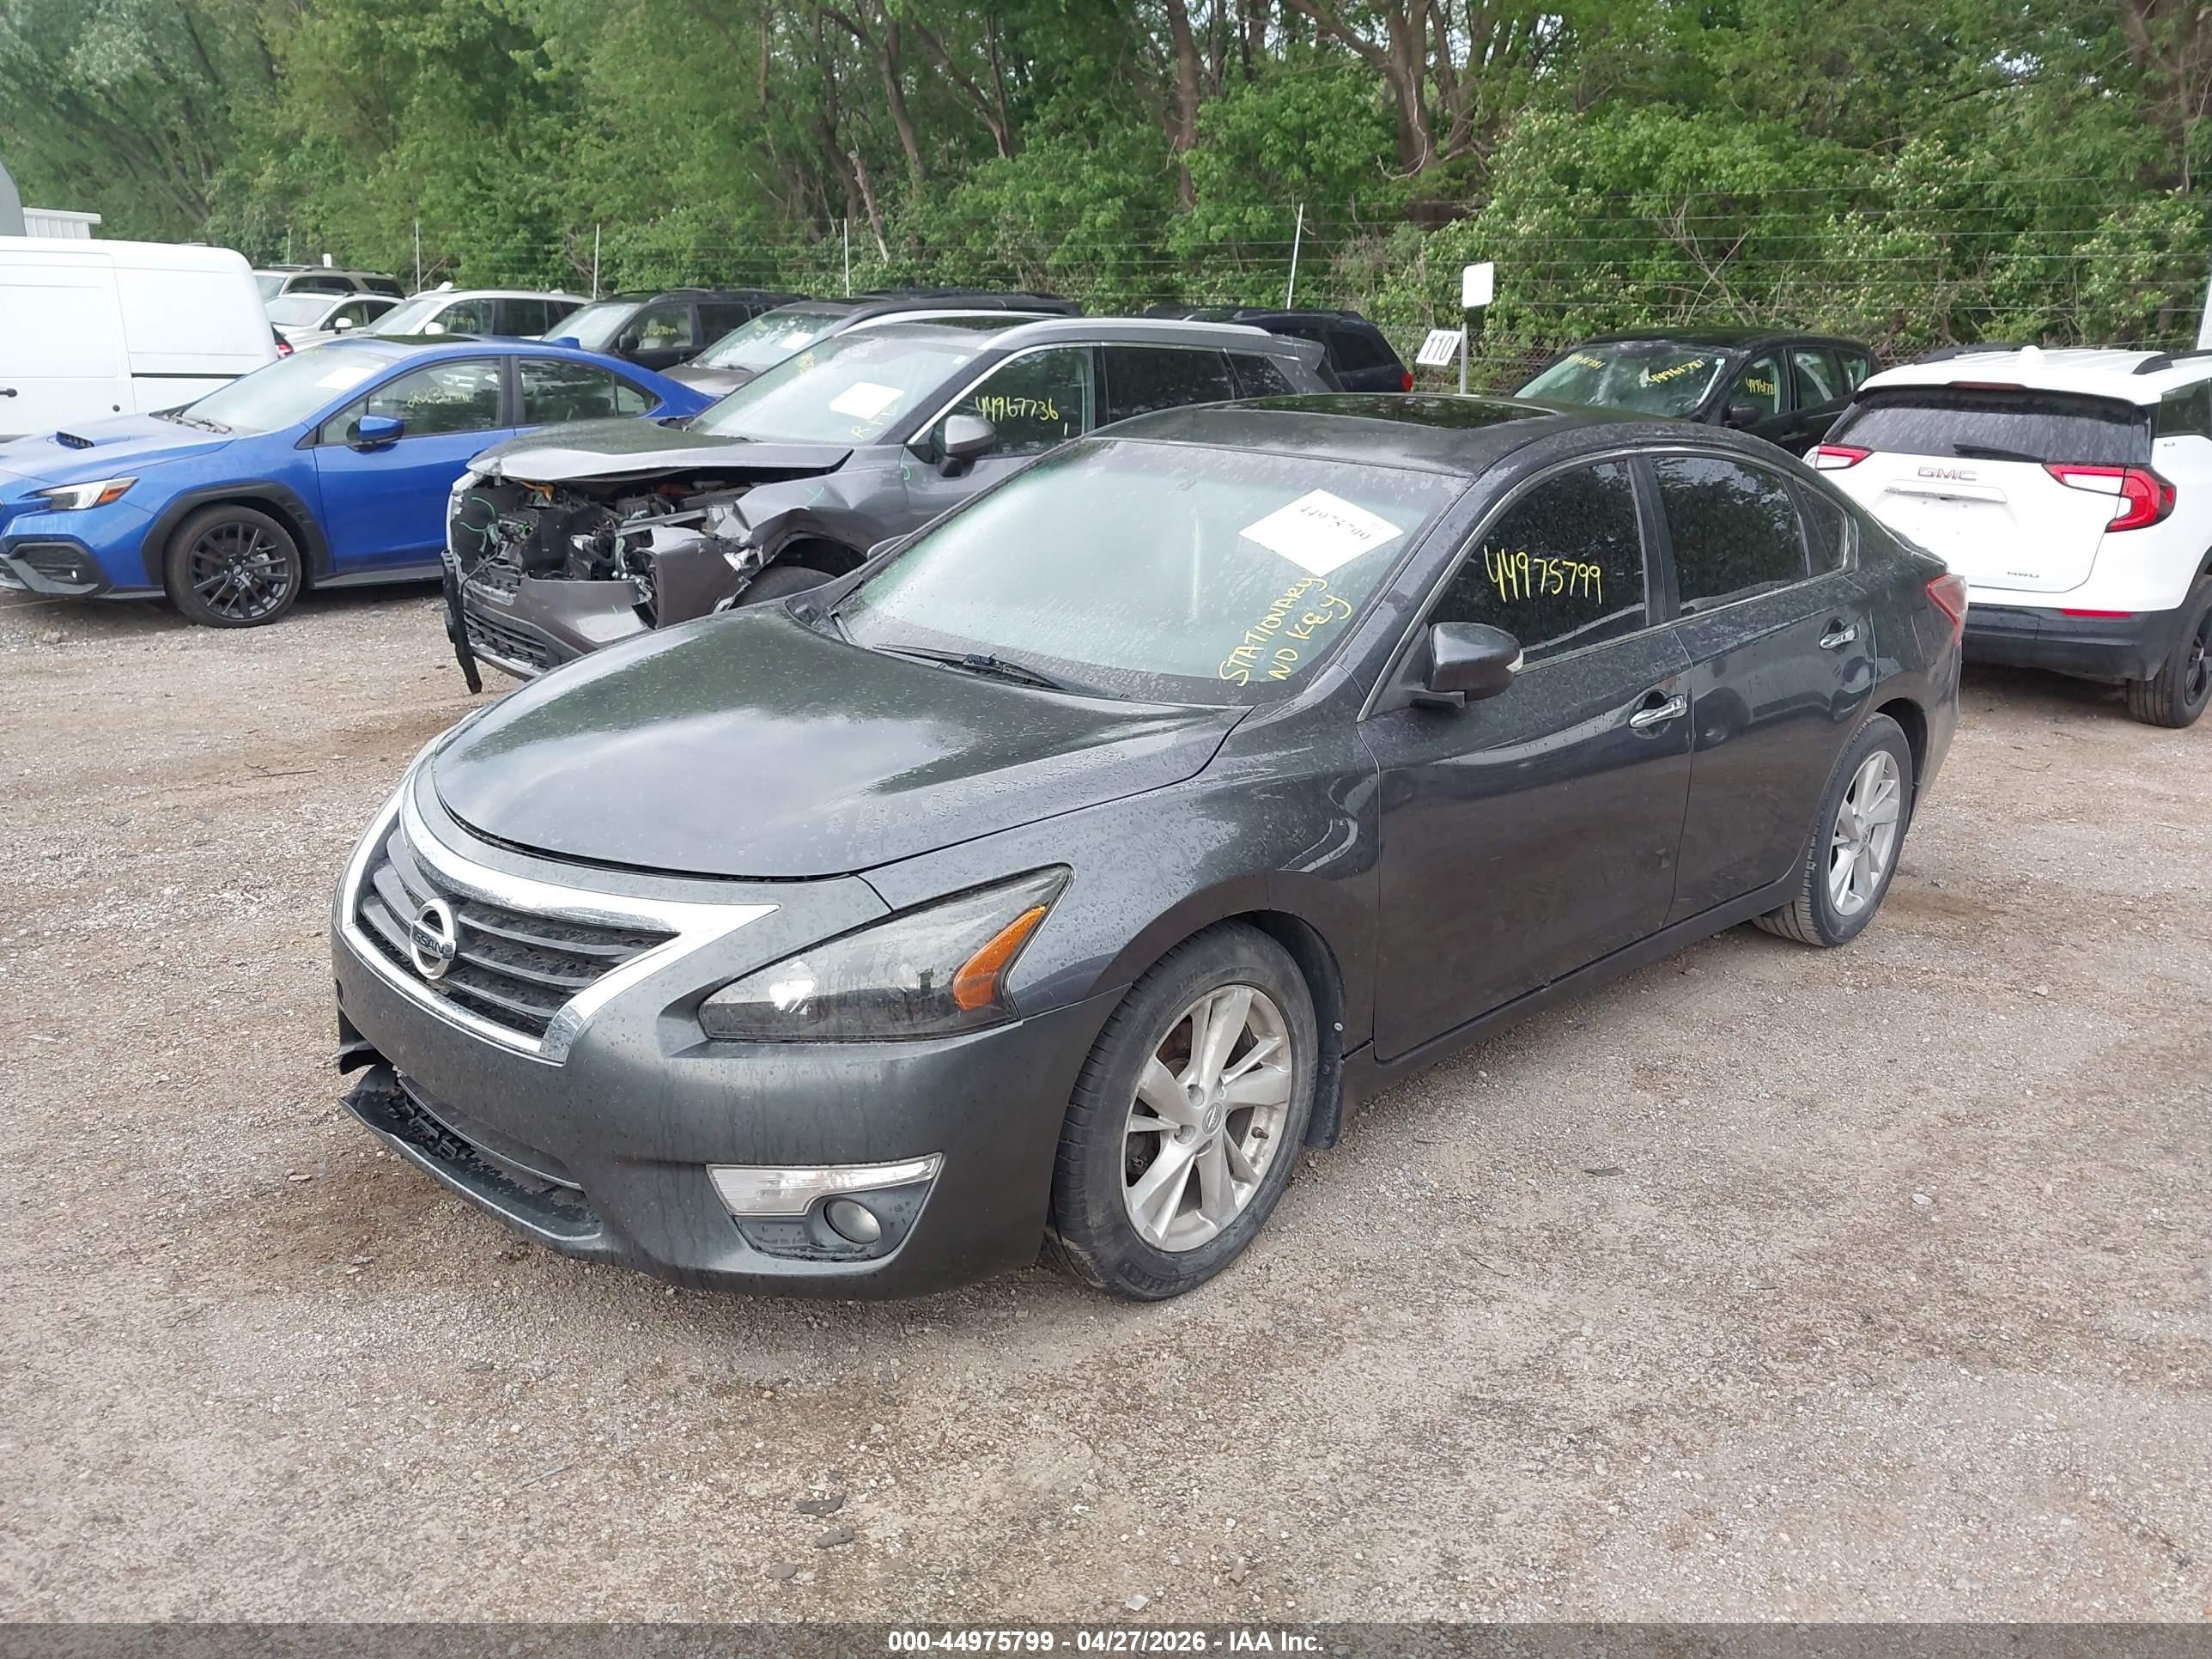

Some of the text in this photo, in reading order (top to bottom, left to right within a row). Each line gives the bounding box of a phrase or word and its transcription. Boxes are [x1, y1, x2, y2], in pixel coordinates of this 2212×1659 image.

[1425, 334, 1455, 361] 110
[975, 396, 1059, 422] 44967736
[1917, 466, 1977, 481] GMC
[1484, 544, 1602, 605] 44975799
[1219, 578, 1328, 687] STATIONARY
[1267, 647, 1298, 680] NO
